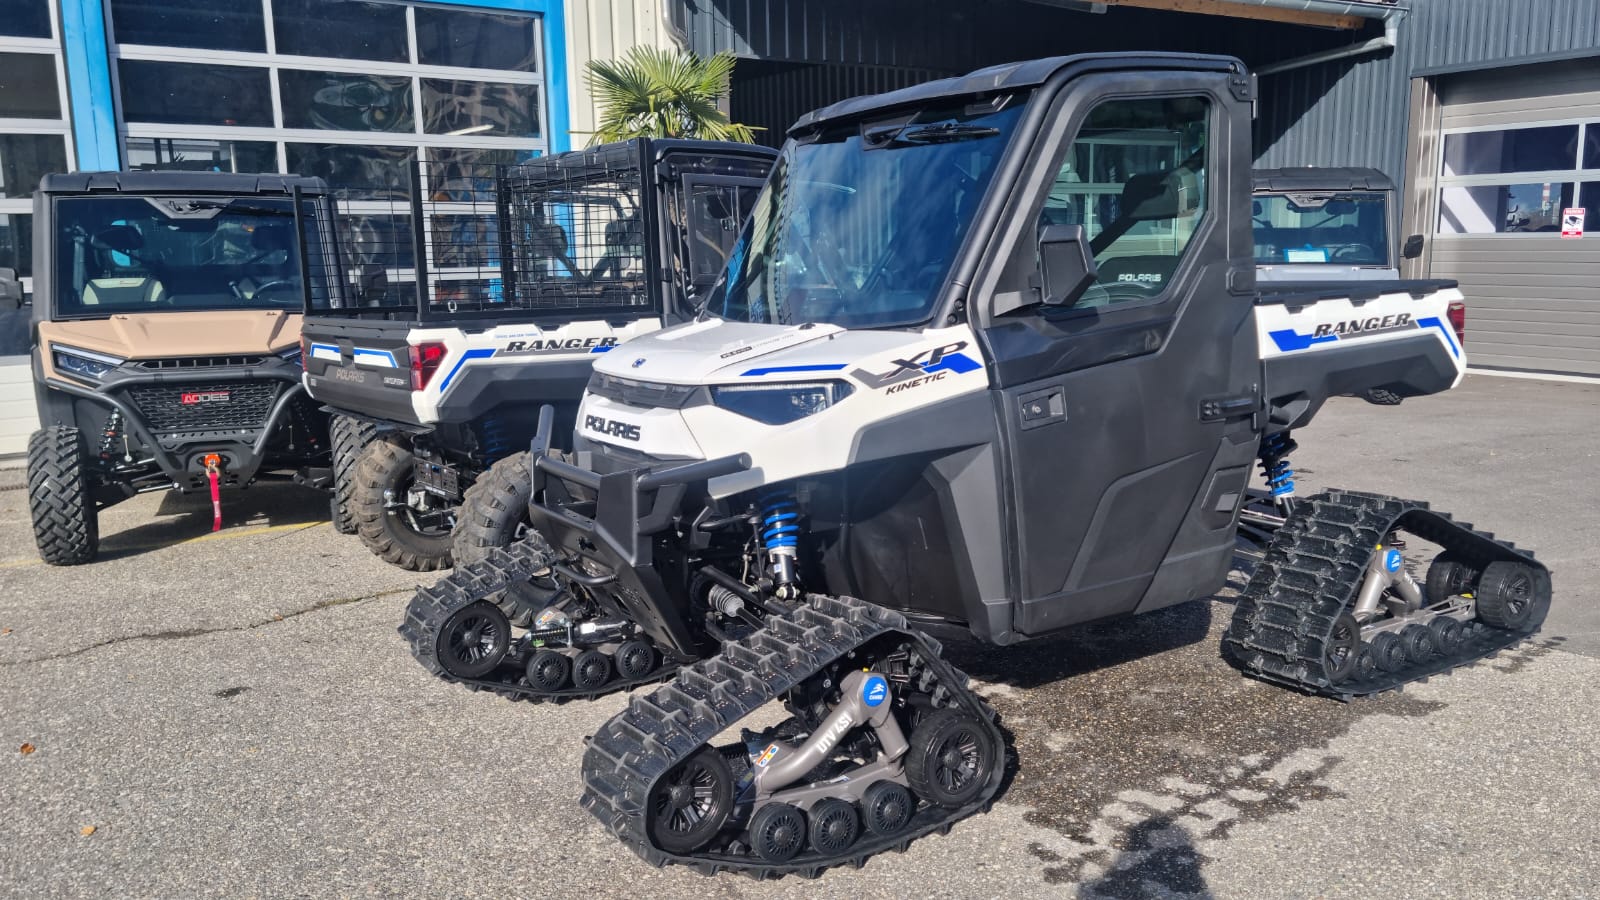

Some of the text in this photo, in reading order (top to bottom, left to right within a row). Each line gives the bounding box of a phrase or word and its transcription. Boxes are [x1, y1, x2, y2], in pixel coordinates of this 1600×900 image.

[1117, 273, 1162, 282] POLARIS
[1312, 313, 1411, 338] RANGER
[505, 337, 618, 352] RANGER
[882, 340, 968, 379] XP
[335, 368, 366, 383] POLARIS
[885, 371, 947, 395] KINETIC
[585, 414, 641, 441] POLARIS
[816, 729, 836, 753] UTV
